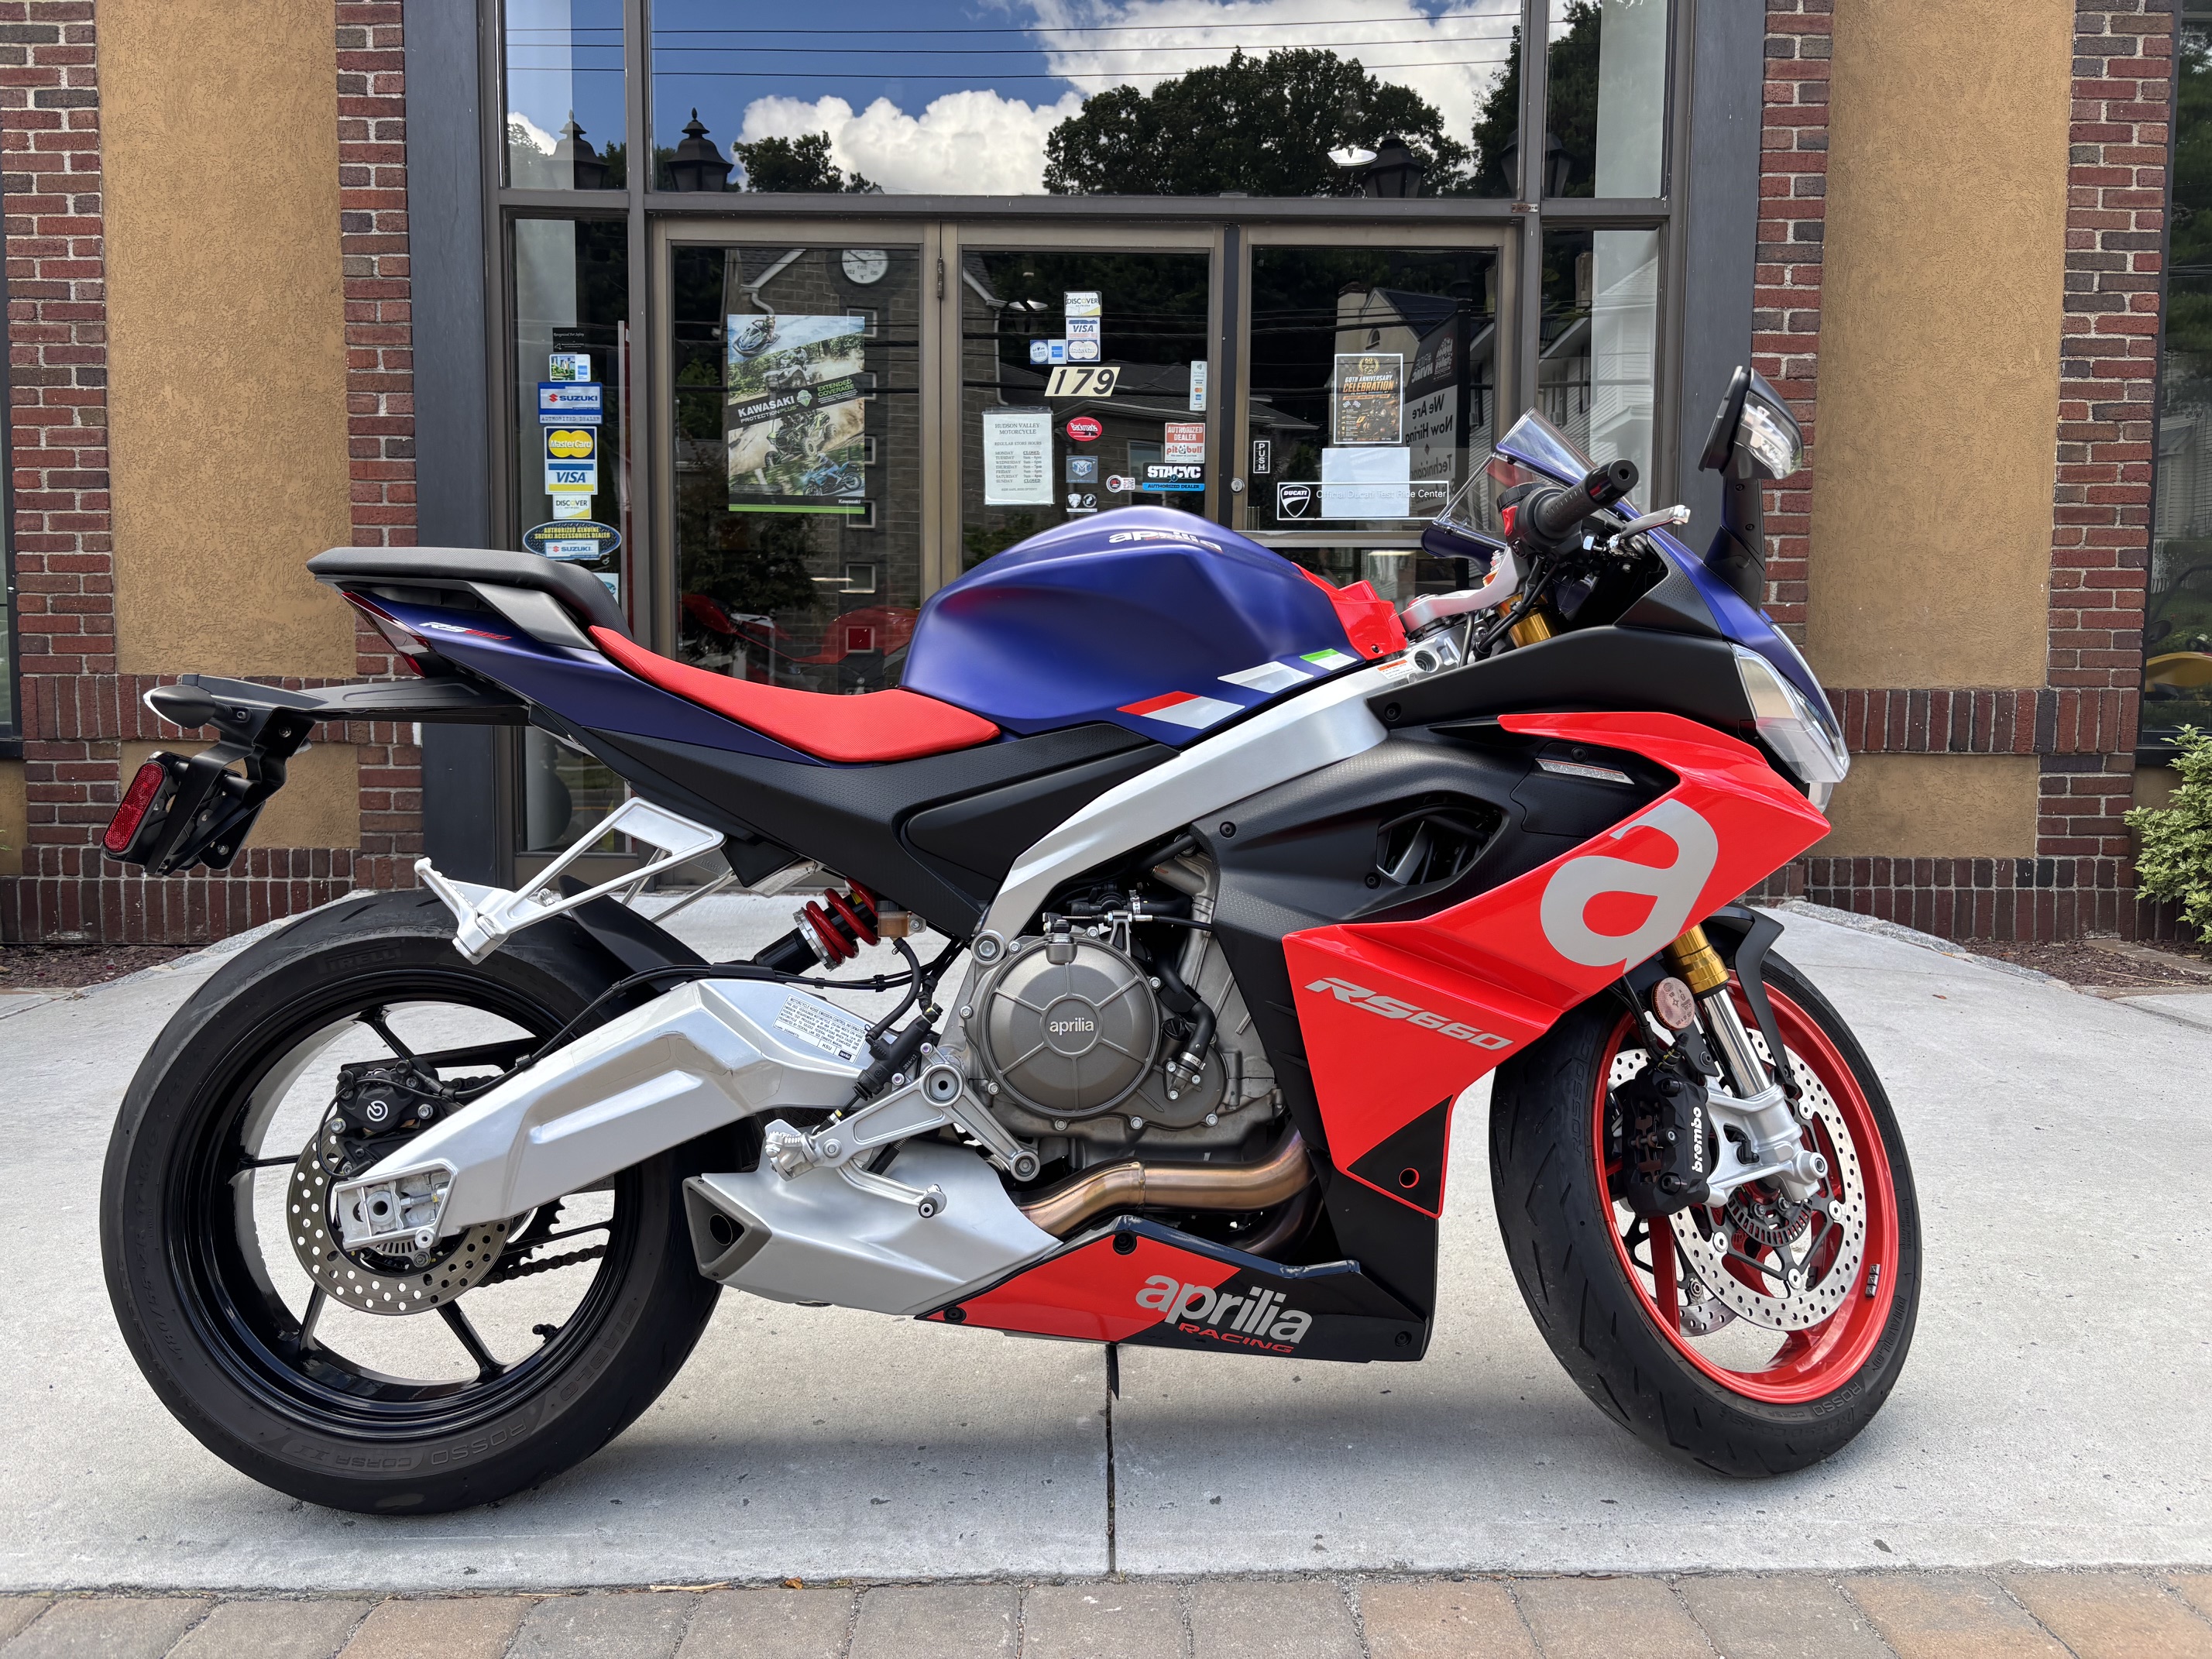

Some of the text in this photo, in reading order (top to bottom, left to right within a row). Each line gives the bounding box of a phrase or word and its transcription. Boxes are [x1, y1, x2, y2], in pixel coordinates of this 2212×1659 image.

[817, 379, 852, 392] EXTENDED
[818, 383, 855, 397] COVERAGE
[1054, 369, 1115, 395] 179
[1342, 380, 1394, 393] CELEBRATION
[737, 396, 795, 417] KAWASAKI
[550, 440, 592, 448] MasterCard
[1166, 445, 1178, 455] pit
[556, 472, 586, 483] VISA
[1147, 465, 1201, 479] STACYC
[1316, 490, 1345, 499] Official
[1396, 489, 1416, 498] Ride
[1417, 489, 1447, 498] Center
[1108, 531, 1223, 554] aprilia
[1540, 798, 1719, 974] a
[1304, 977, 1514, 1050] RS660
[1049, 1017, 1094, 1036] aprilia
[1571, 1062, 1585, 1157] ROSSO
[1690, 1106, 1703, 1173] brembo
[1135, 1274, 1313, 1344] aprilia
[1178, 1322, 1295, 1353] RACING
[559, 1303, 638, 1401] DIABLO
[1812, 1382, 1863, 1417] ROSSO
[431, 1418, 527, 1465] ROSSO
[335, 1455, 412, 1468] CORSA
